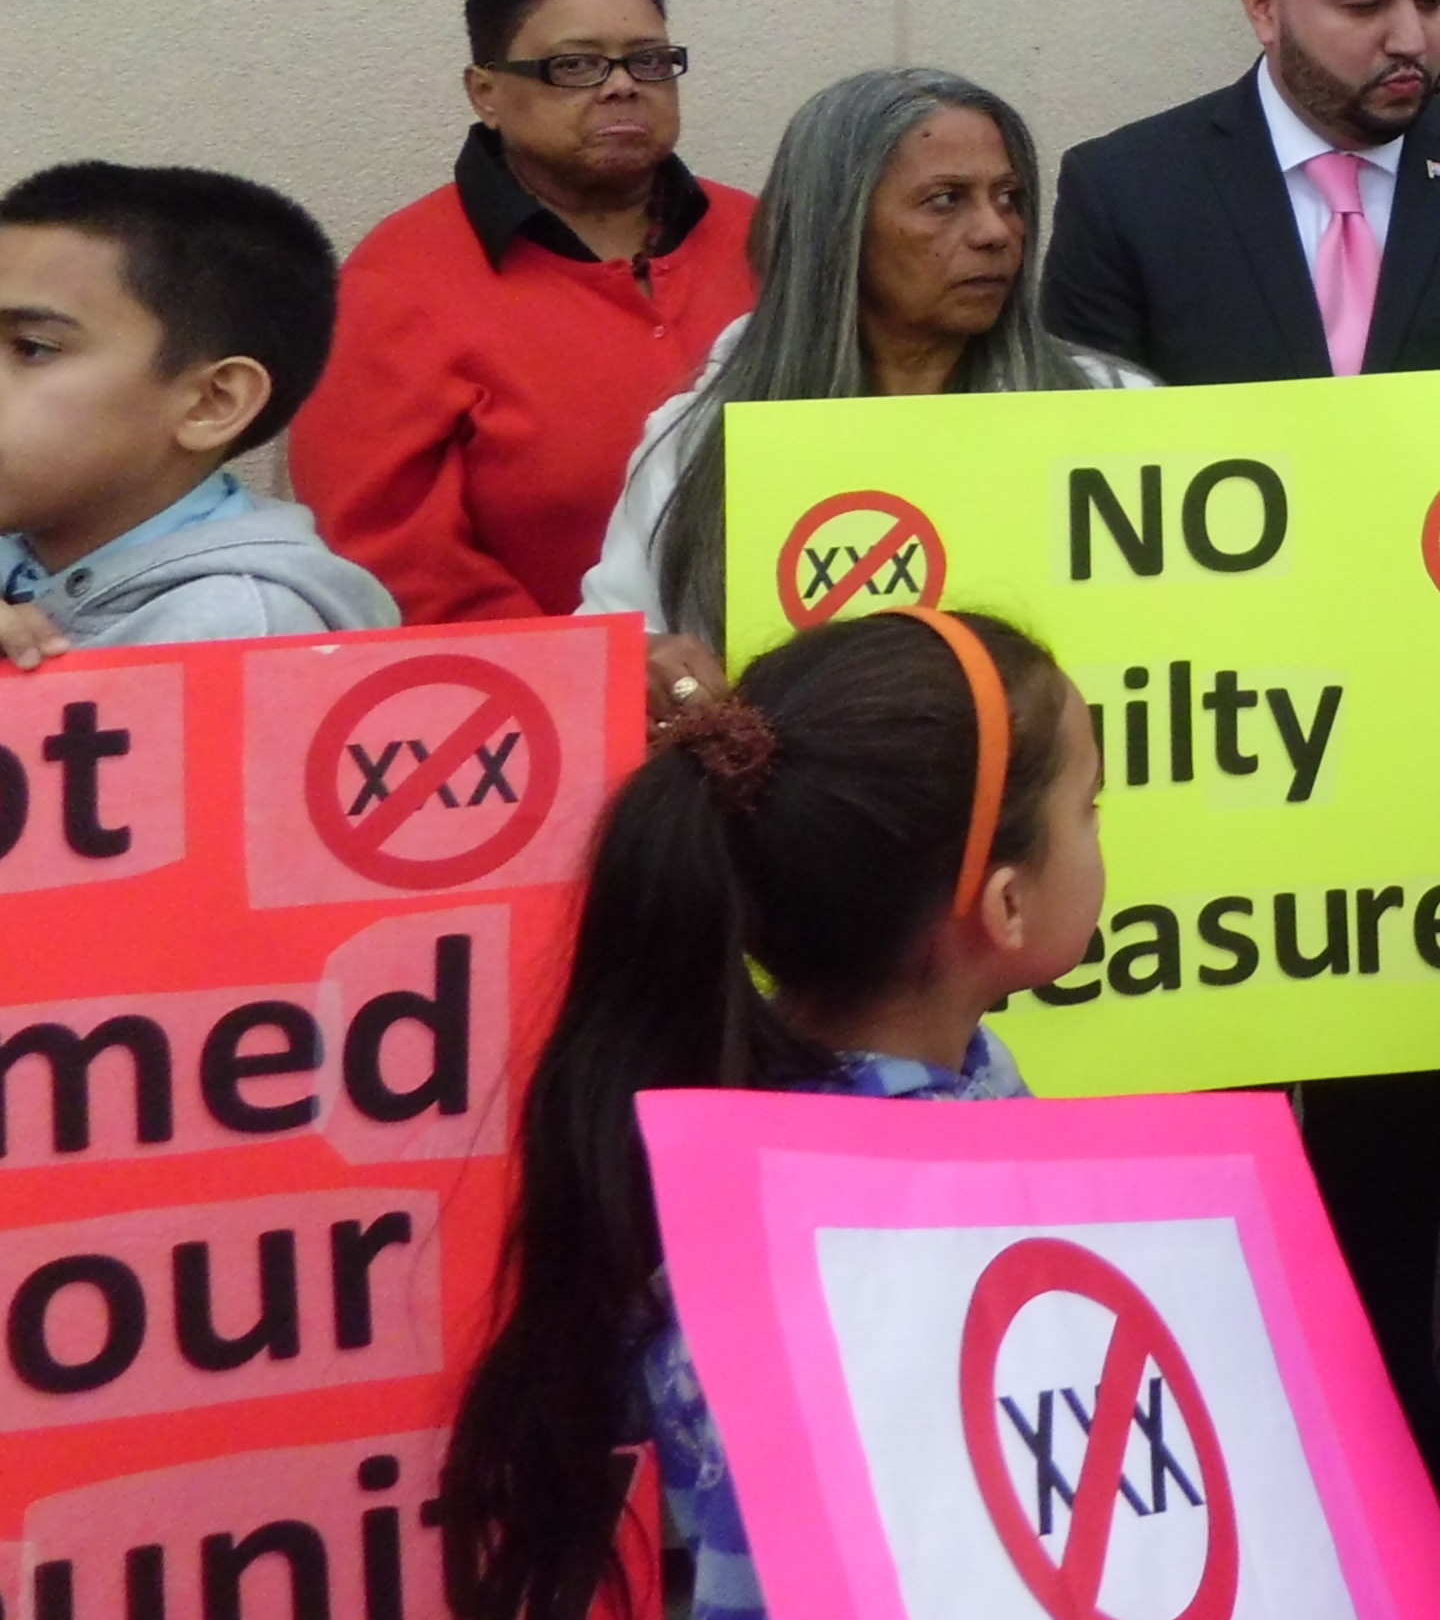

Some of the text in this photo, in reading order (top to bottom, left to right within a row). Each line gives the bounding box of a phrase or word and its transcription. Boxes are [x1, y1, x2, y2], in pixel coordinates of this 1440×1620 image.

[1068, 458, 1290, 581] NO
[1088, 660, 1344, 803] ilty
[6, 1209, 412, 1395] our
